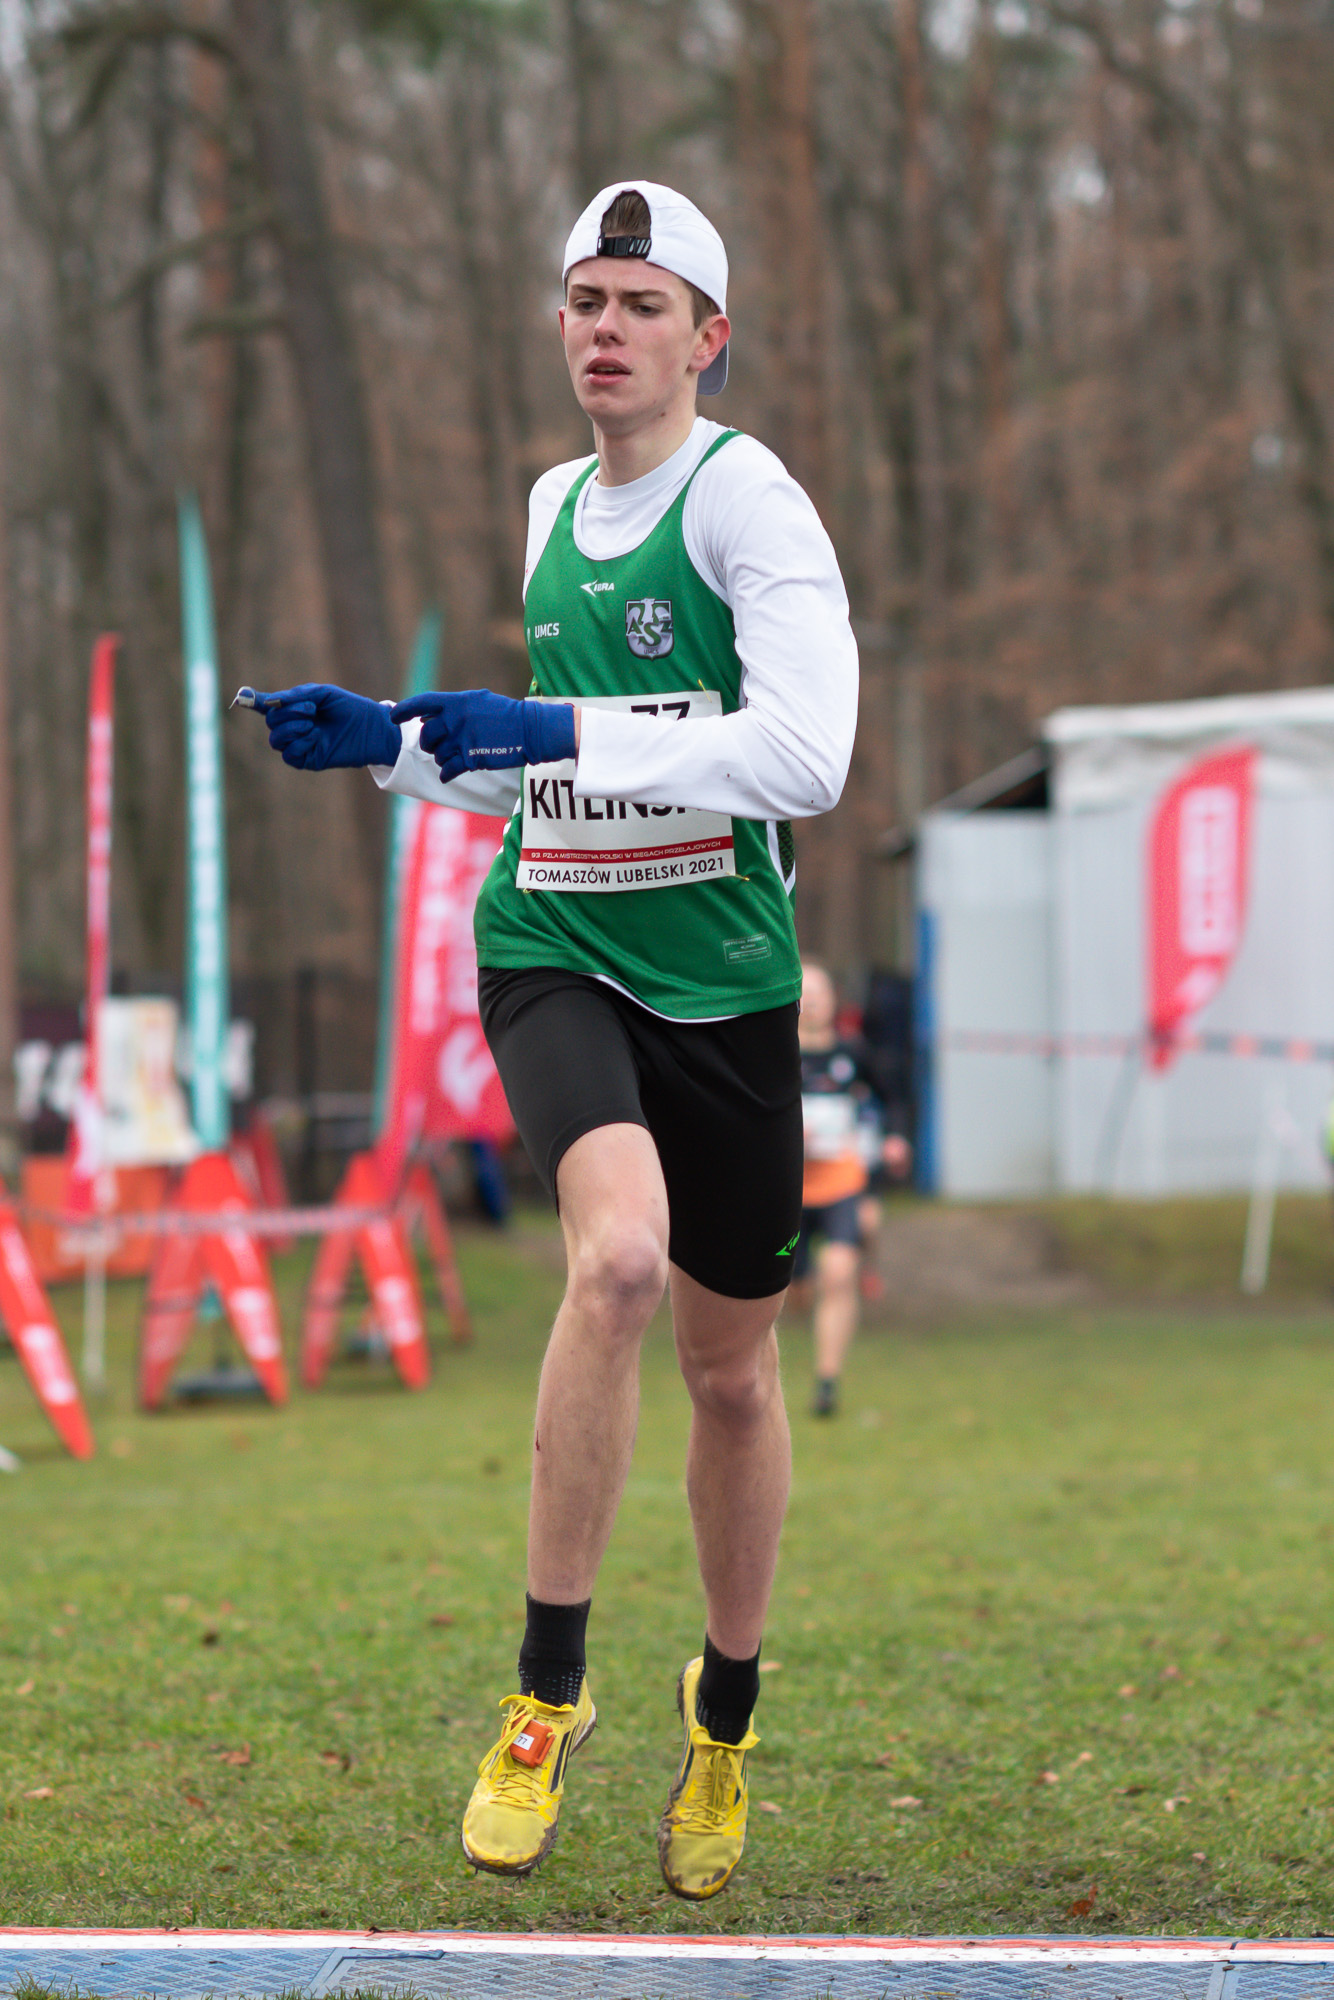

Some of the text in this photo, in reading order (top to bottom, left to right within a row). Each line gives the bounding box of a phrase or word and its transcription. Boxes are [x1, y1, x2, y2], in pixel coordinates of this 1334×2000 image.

[534, 622, 560, 639] UMCS
[491, 747, 507, 755] FOR
[632, 850, 664, 858] BIEGACH
[528, 856, 724, 884] TOMASZÓW LUBELSKI 2021
[517, 1735, 528, 1745] 77
